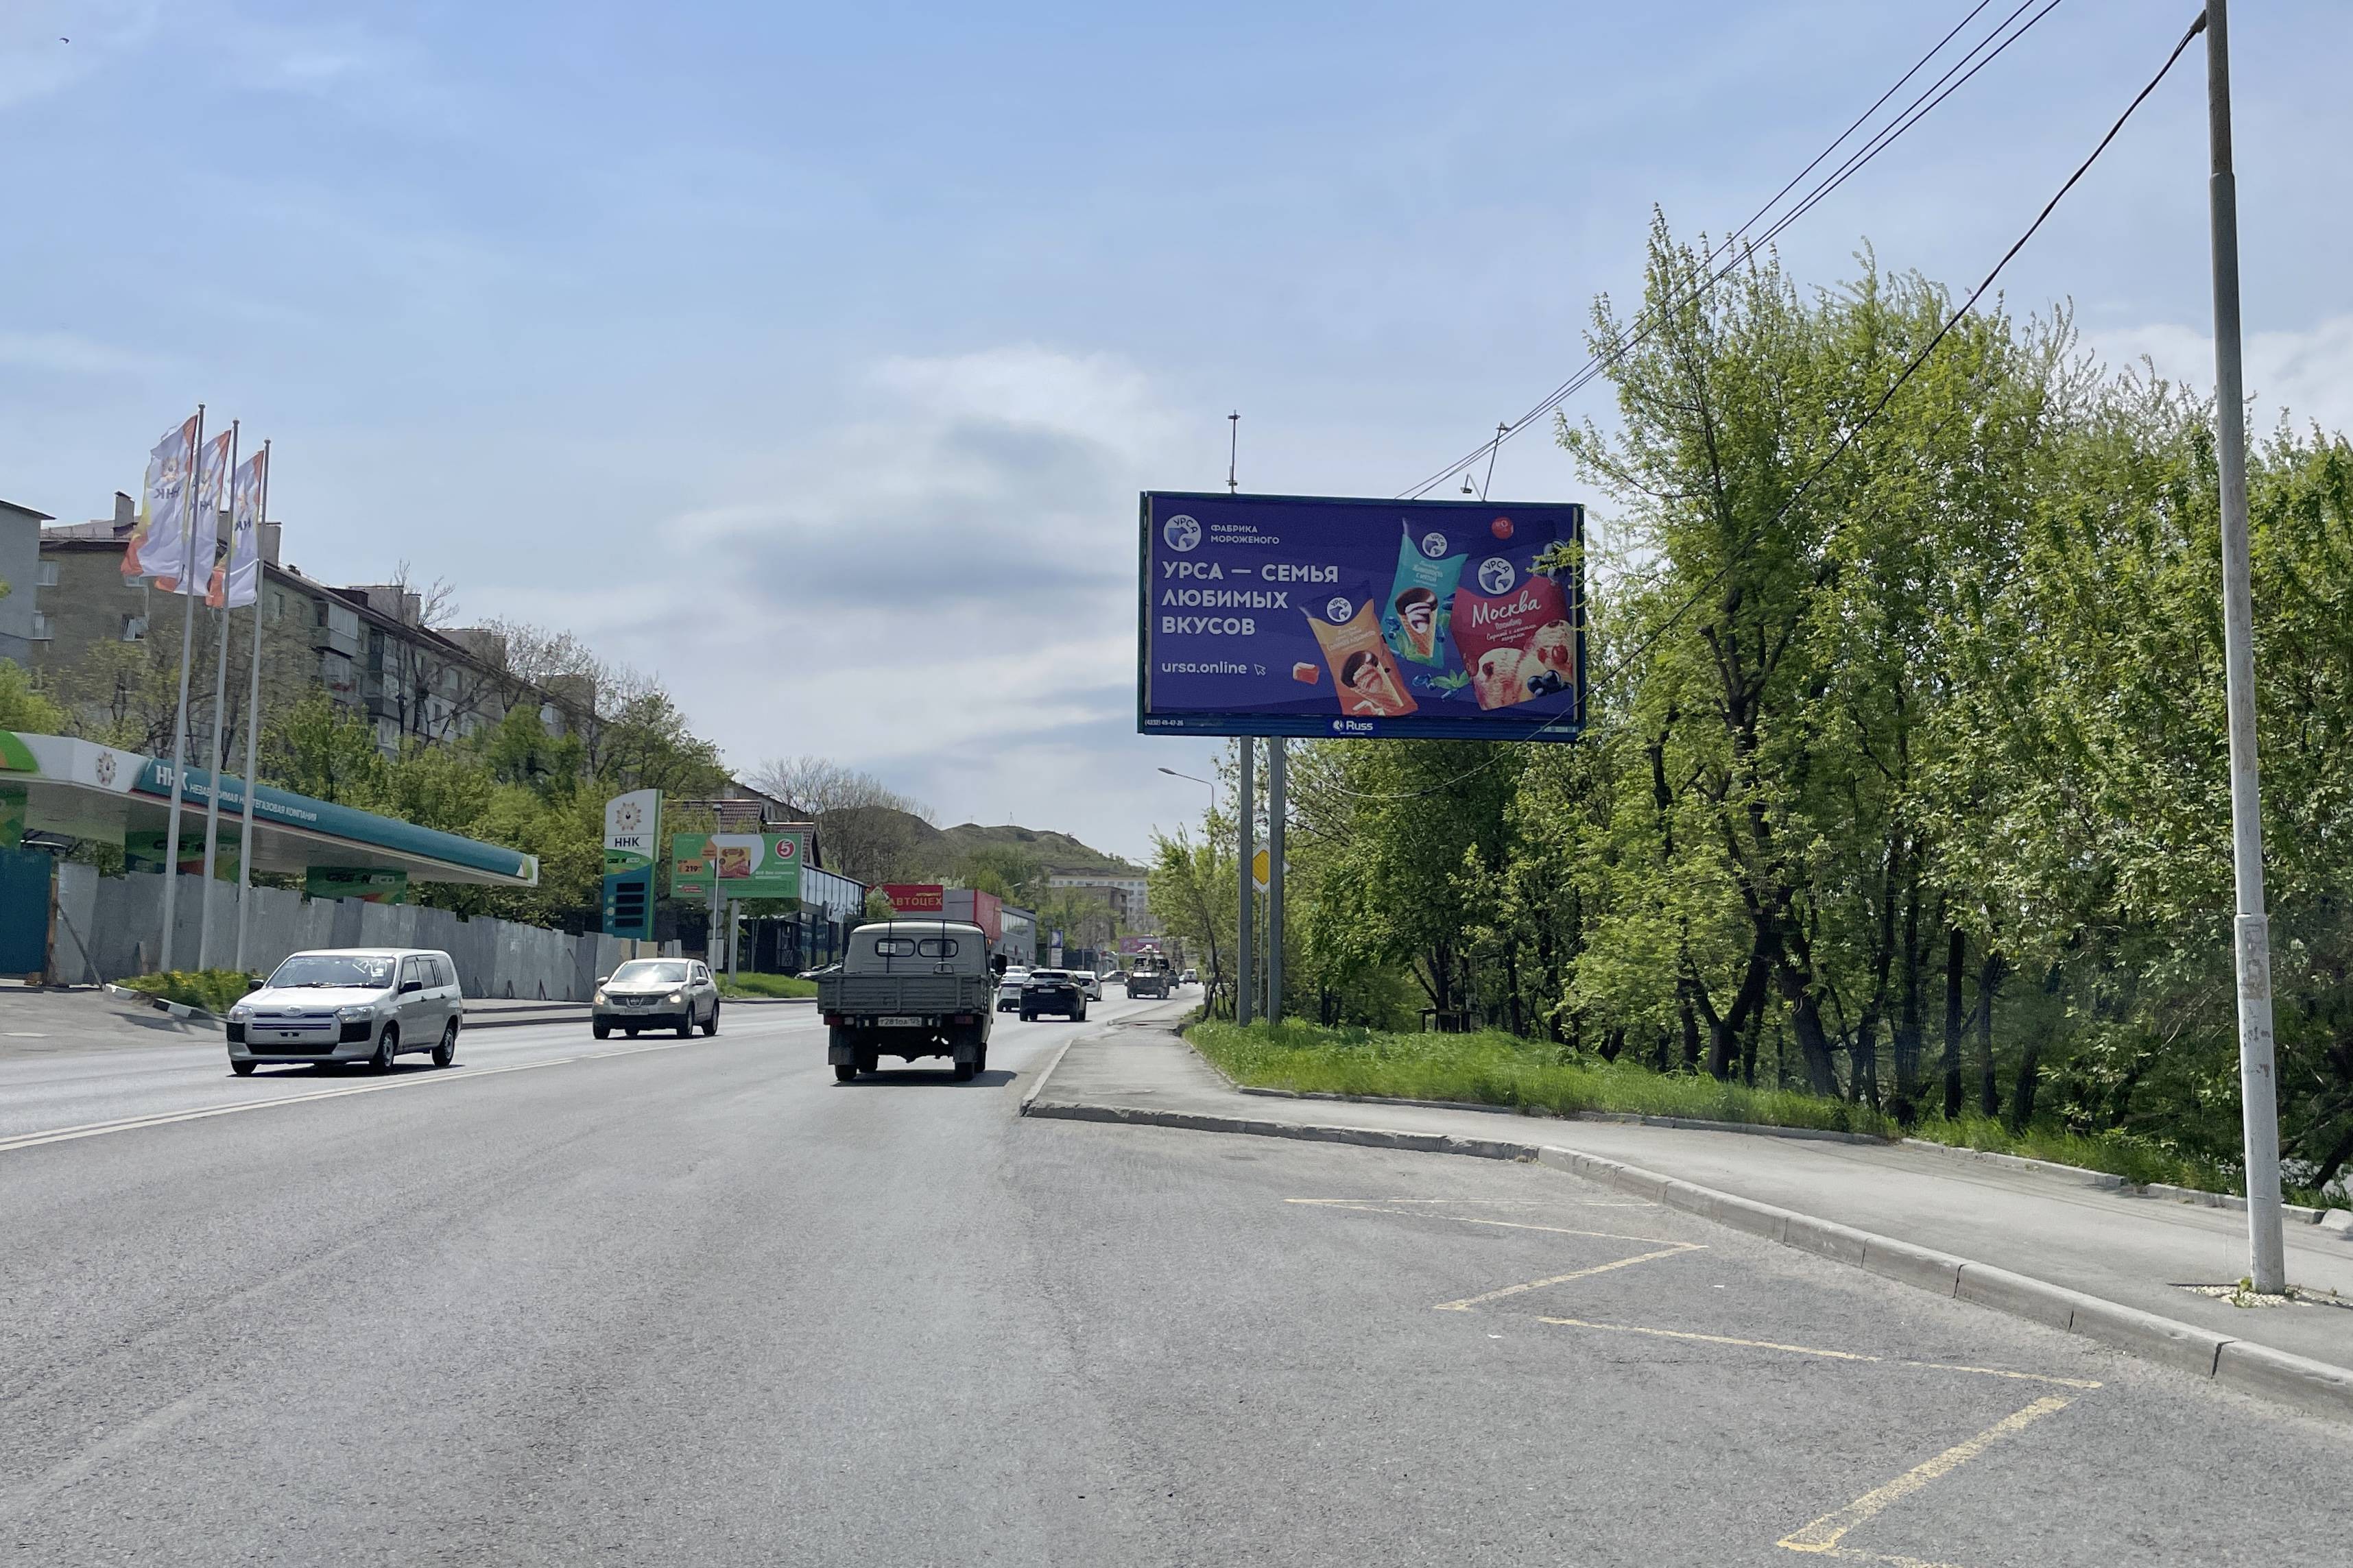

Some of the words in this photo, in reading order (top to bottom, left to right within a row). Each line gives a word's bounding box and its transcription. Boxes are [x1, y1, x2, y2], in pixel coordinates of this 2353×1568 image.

[1173, 517, 1198, 533] УРСА
[1210, 524, 1258, 533] ФАБРИКА
[1210, 535, 1280, 544] МОРОЖЕНОГО
[1162, 561, 1223, 579] УРСА
[1261, 564, 1339, 583] СЕМЬЯ
[1484, 560, 1510, 574] УРСА
[1162, 589, 1289, 609] ЛЮБИМЫХ
[1472, 590, 1541, 628] Москва
[1162, 616, 1256, 636] ВКУСОВ
[1162, 661, 1247, 674] ursa.online
[1346, 721, 1373, 731] Russ
[615, 837, 640, 847] ННК
